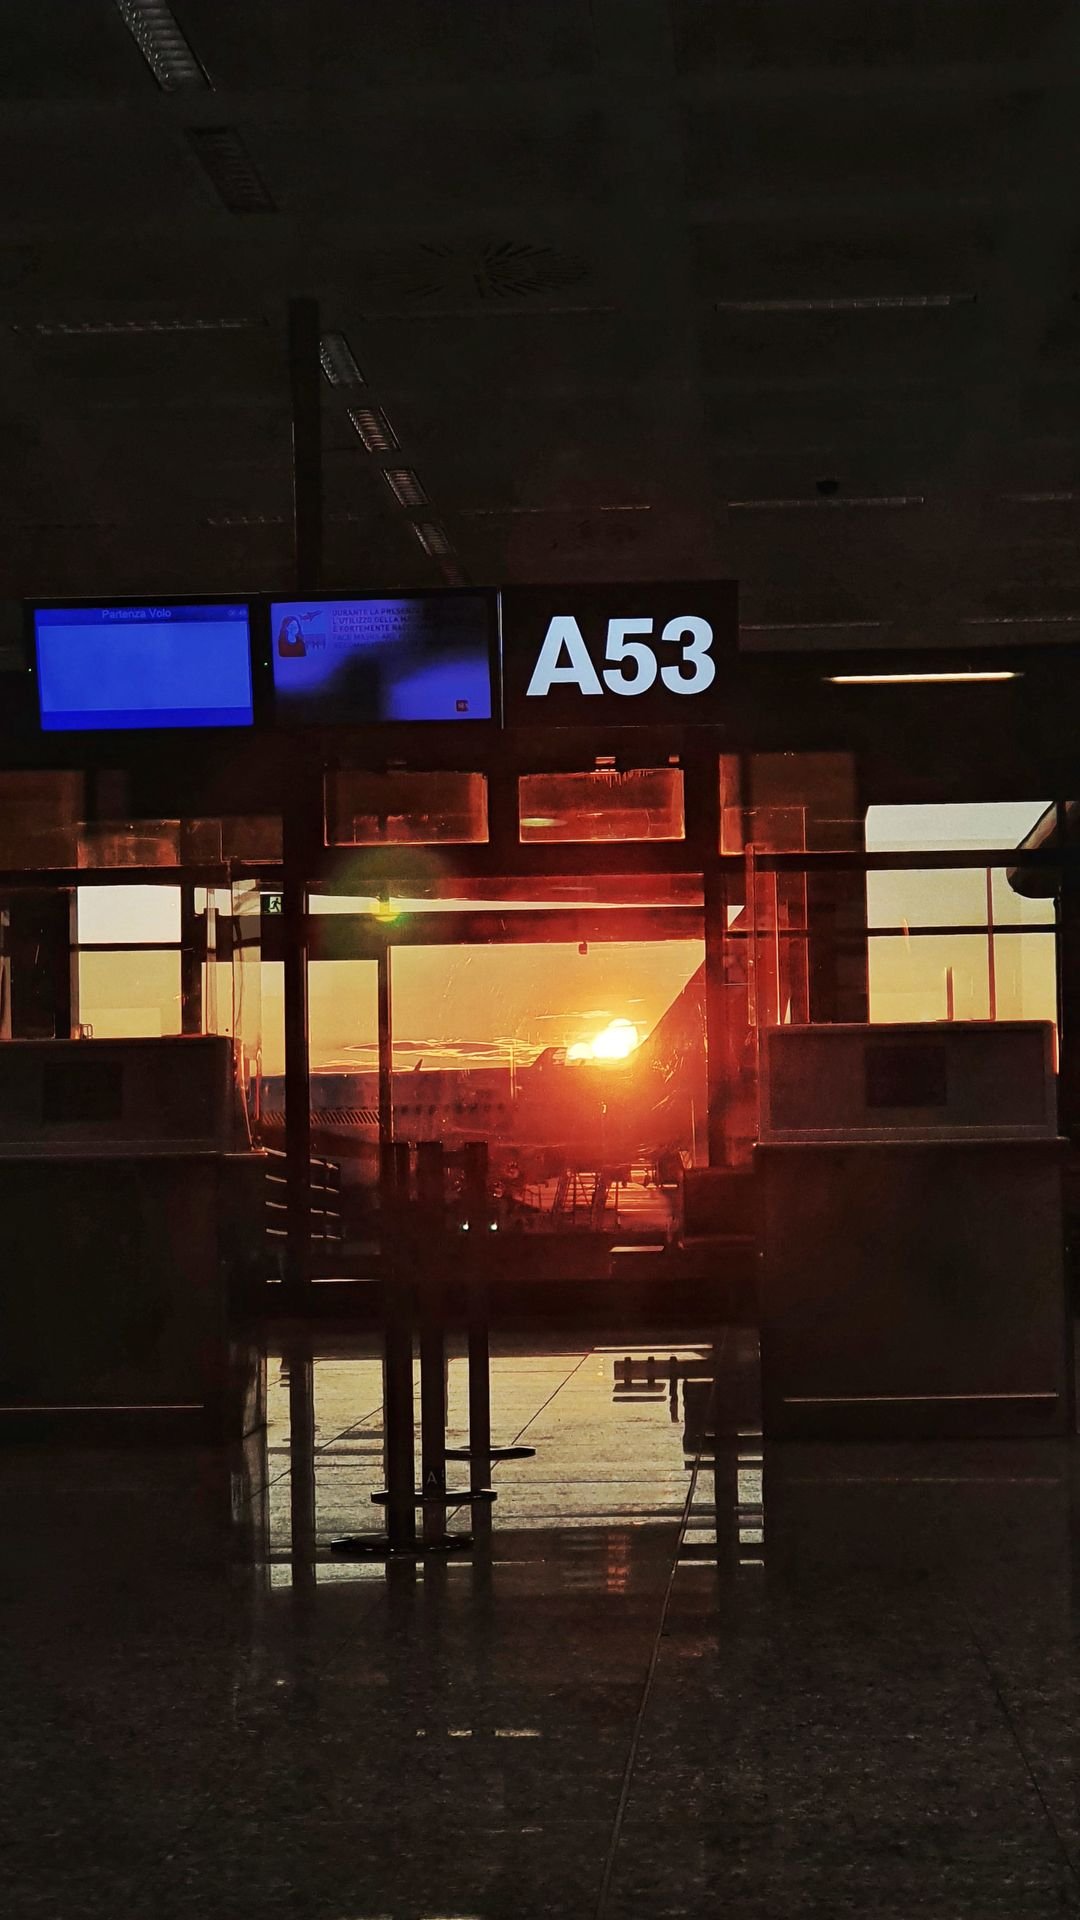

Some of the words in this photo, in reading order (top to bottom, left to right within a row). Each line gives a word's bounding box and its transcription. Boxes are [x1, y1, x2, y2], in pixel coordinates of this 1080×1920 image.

[102, 609, 146, 619] Partenza
[149, 608, 172, 618] Volo
[332, 608, 367, 616] DURANTE
[526, 615, 716, 696] A53
